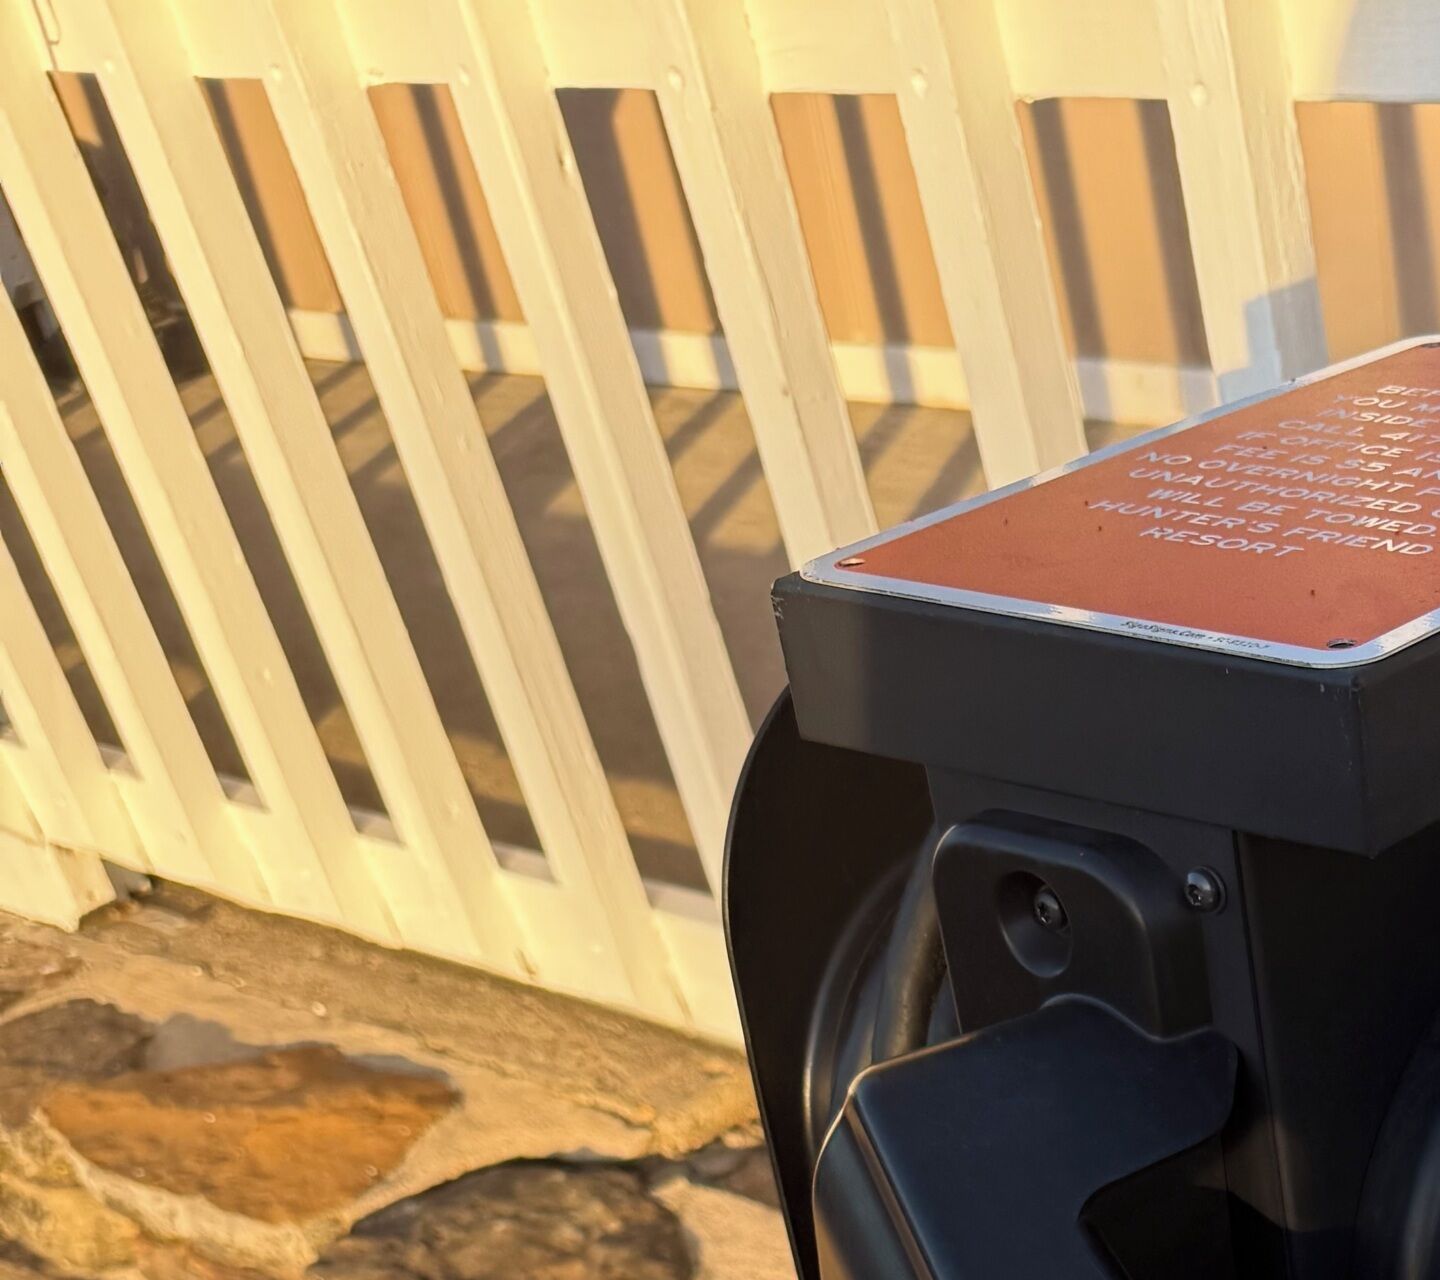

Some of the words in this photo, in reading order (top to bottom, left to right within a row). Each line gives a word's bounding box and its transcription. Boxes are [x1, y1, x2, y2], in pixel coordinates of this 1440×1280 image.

[1334, 394, 1407, 409] YOU
[1278, 419, 1364, 438] CALL
[1316, 408, 1440, 428] INSIDE
[1213, 444, 1289, 460] FEE
[1290, 454, 1332, 465] IS
[1236, 431, 1277, 441] IF
[1280, 435, 1414, 459] OFFICE
[1140, 451, 1193, 466] NO
[1197, 458, 1415, 494] OVERNIGHT
[1128, 467, 1421, 514] UNAUTHORIZED
[1145, 487, 1225, 508] WILL
[1236, 501, 1297, 516] BE
[1304, 508, 1438, 537] TOWED.
[1090, 500, 1281, 534] HUNTER'S
[1282, 527, 1436, 556] FRIEND
[1140, 527, 1305, 558] RESORT
